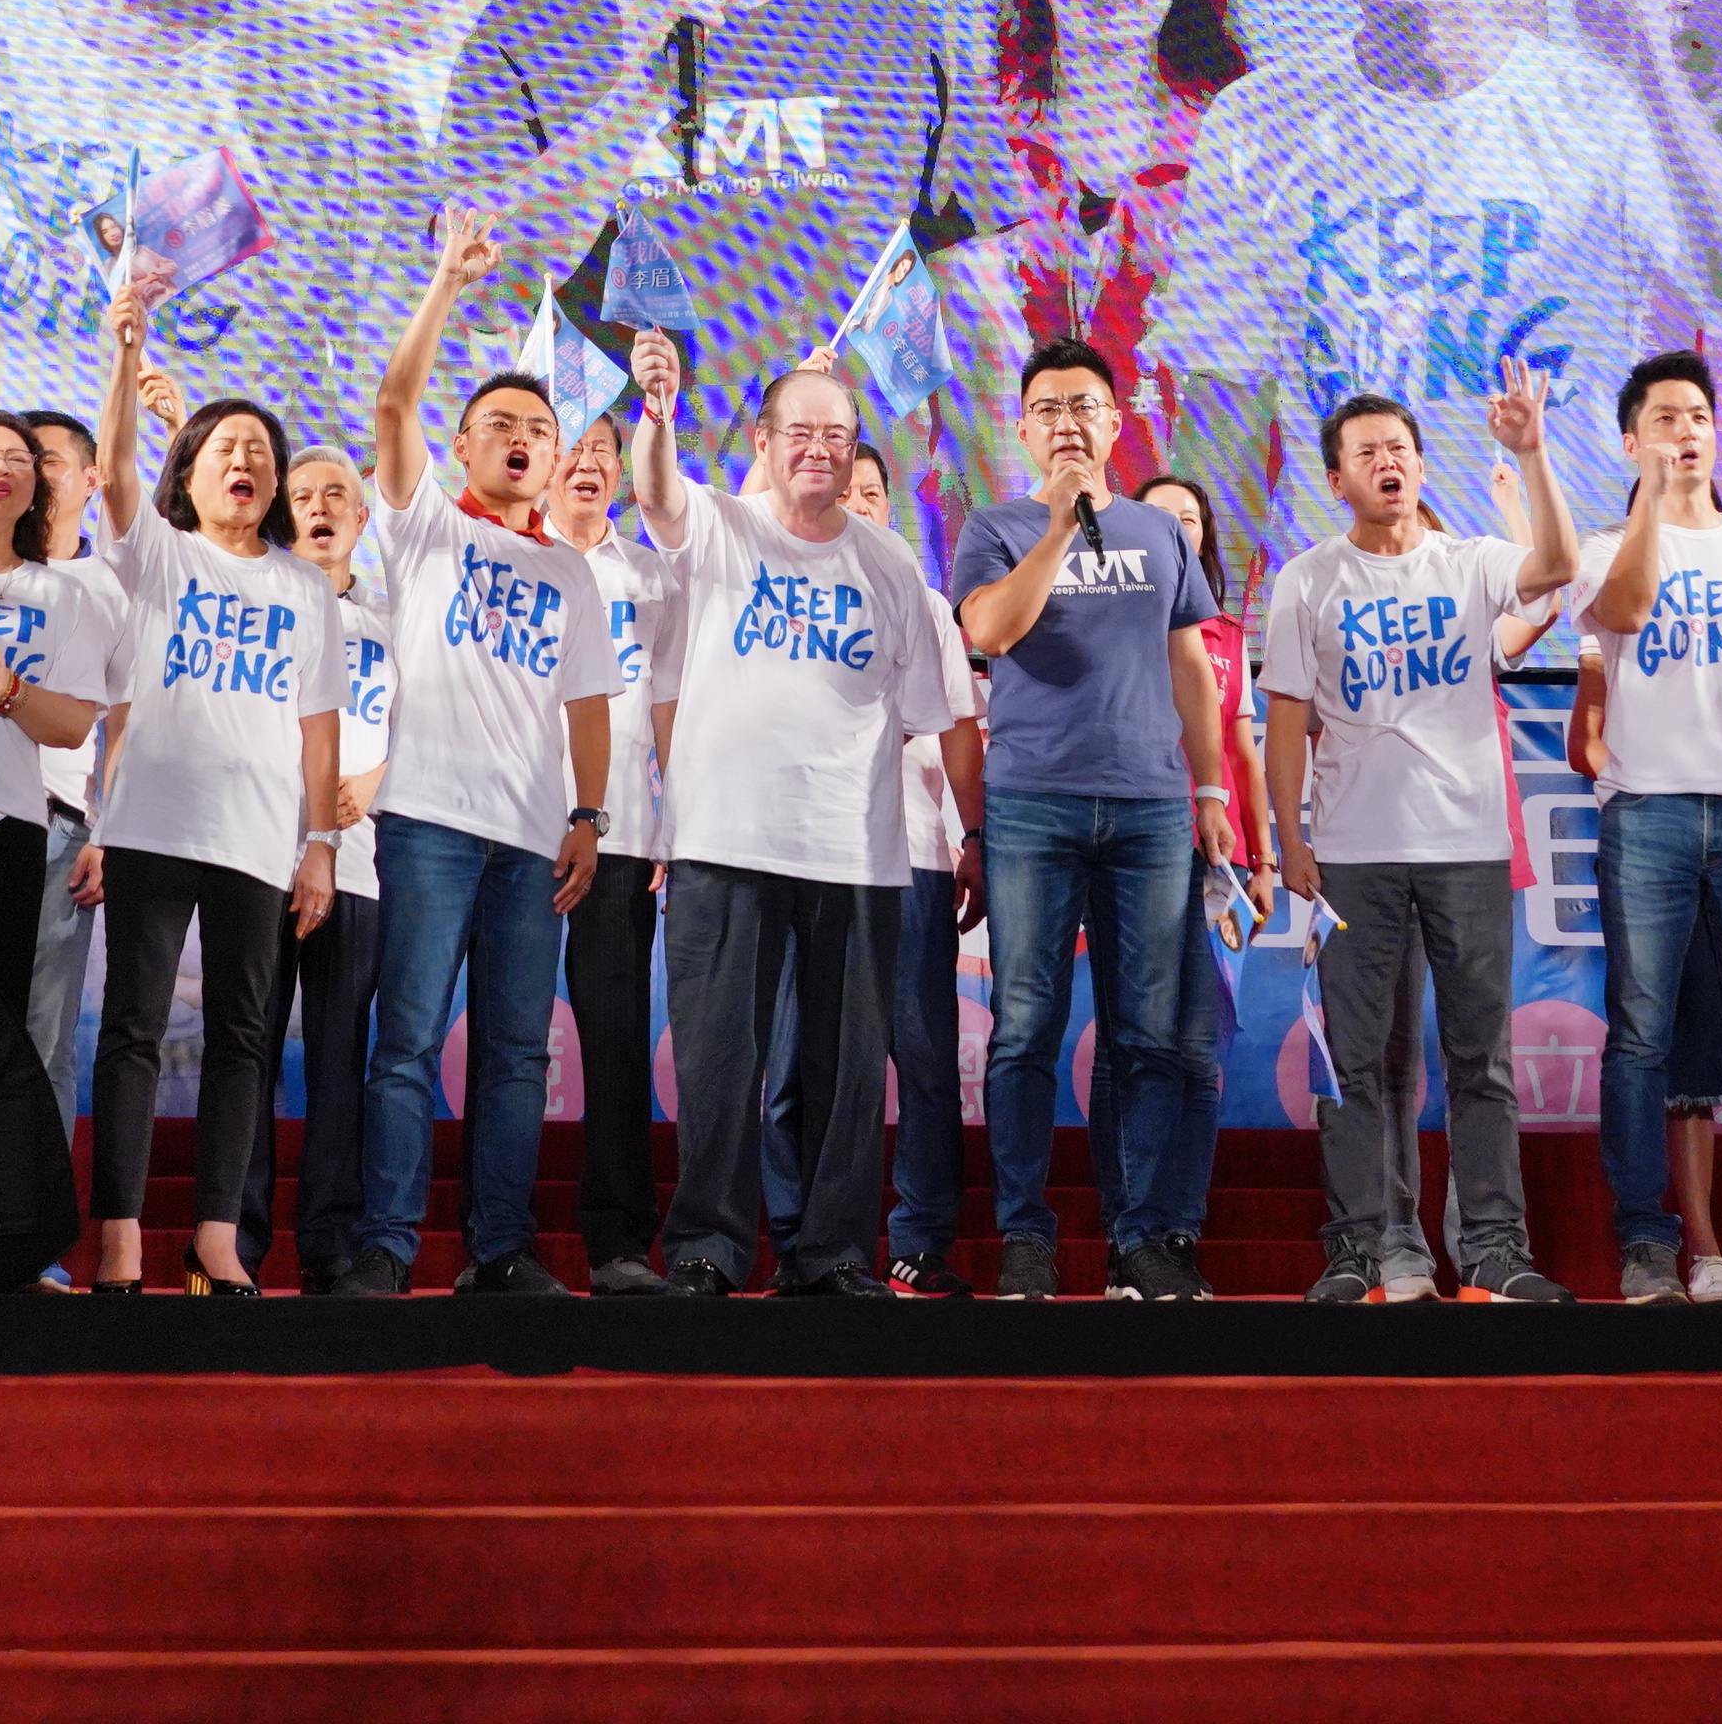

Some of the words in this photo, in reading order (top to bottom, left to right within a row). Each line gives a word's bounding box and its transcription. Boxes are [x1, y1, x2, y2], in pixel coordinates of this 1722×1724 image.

[767, 170, 848, 191] Taiwan
[178, 578, 296, 650] KEEP
[461, 543, 561, 629] KEEP
[751, 560, 863, 626] KEEP
[1078, 584, 1118, 596] Moving
[1121, 583, 1156, 593] Taiwan
[1338, 596, 1458, 652] KEEP
